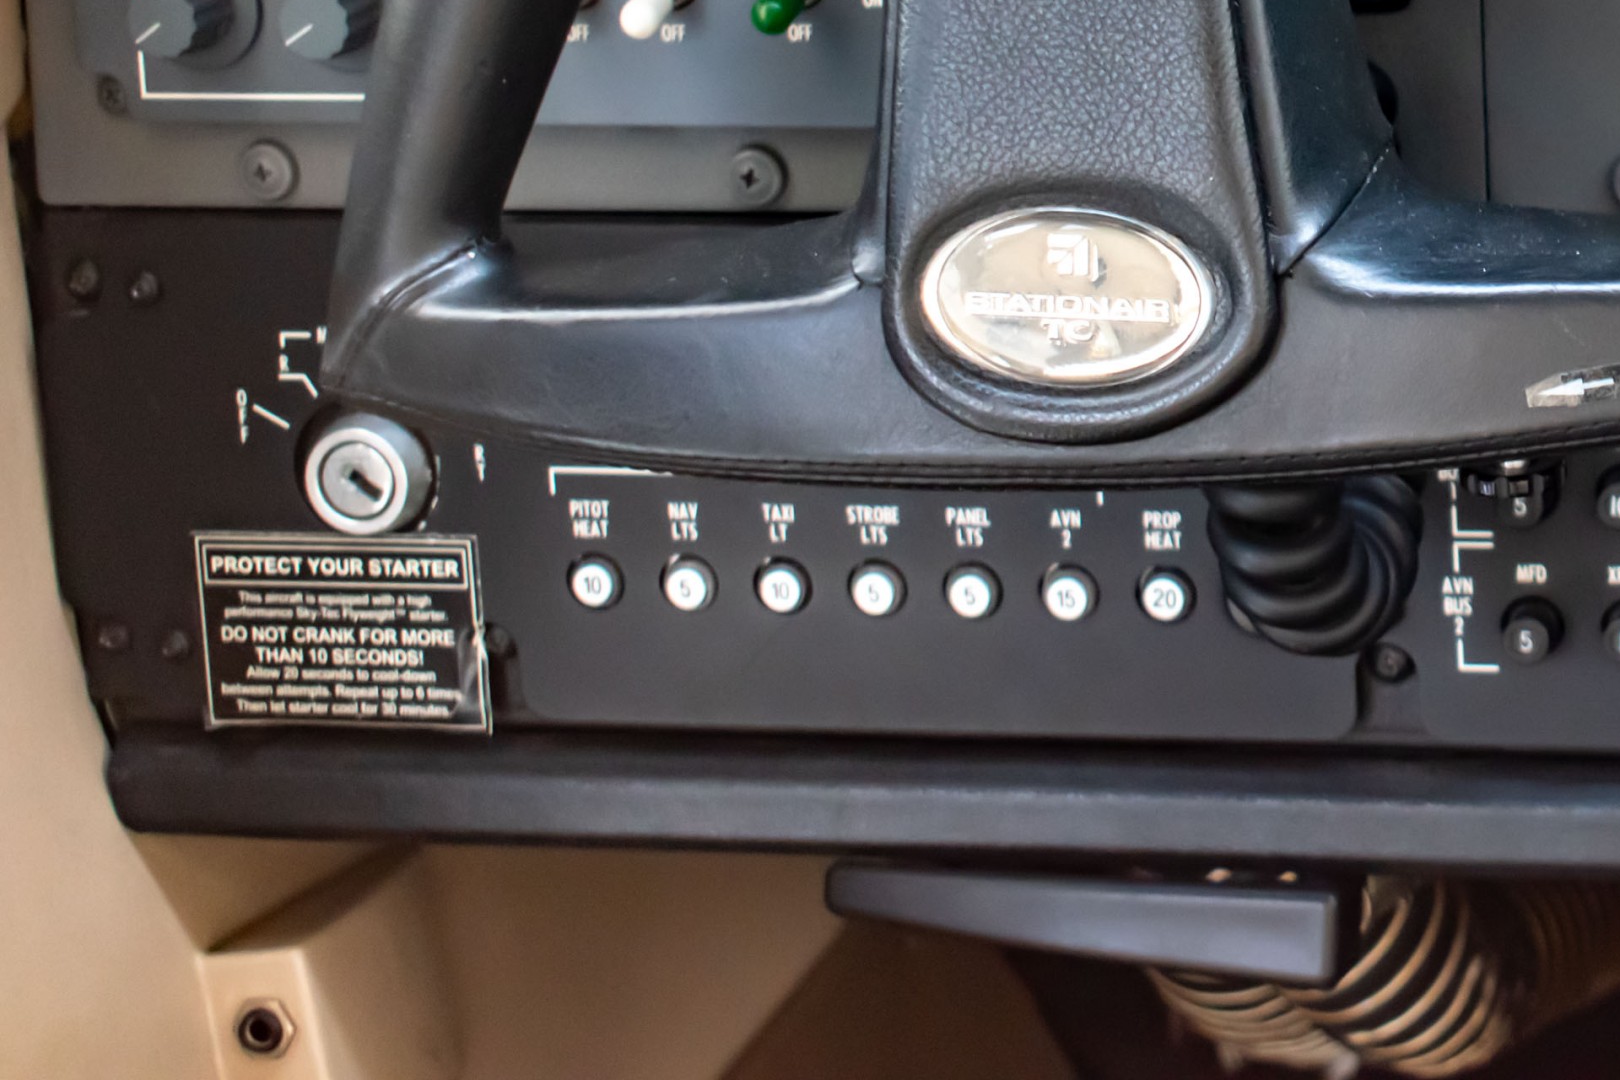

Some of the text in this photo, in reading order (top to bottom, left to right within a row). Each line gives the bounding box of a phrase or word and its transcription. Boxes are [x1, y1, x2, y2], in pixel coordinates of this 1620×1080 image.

[965, 291, 1171, 323] STATIONAIR
[570, 501, 609, 519] PITOT
[573, 520, 608, 539] HEAT
[1143, 511, 1182, 530] PROP
[1145, 530, 1182, 550] HEAT
[210, 555, 460, 579] PROTECT YOUR STARTER
[1152, 588, 1177, 608] 20
[221, 626, 455, 647] DO NOT CRANK FOR MORE
[255, 647, 424, 666] THAN 10 SECONDS!
